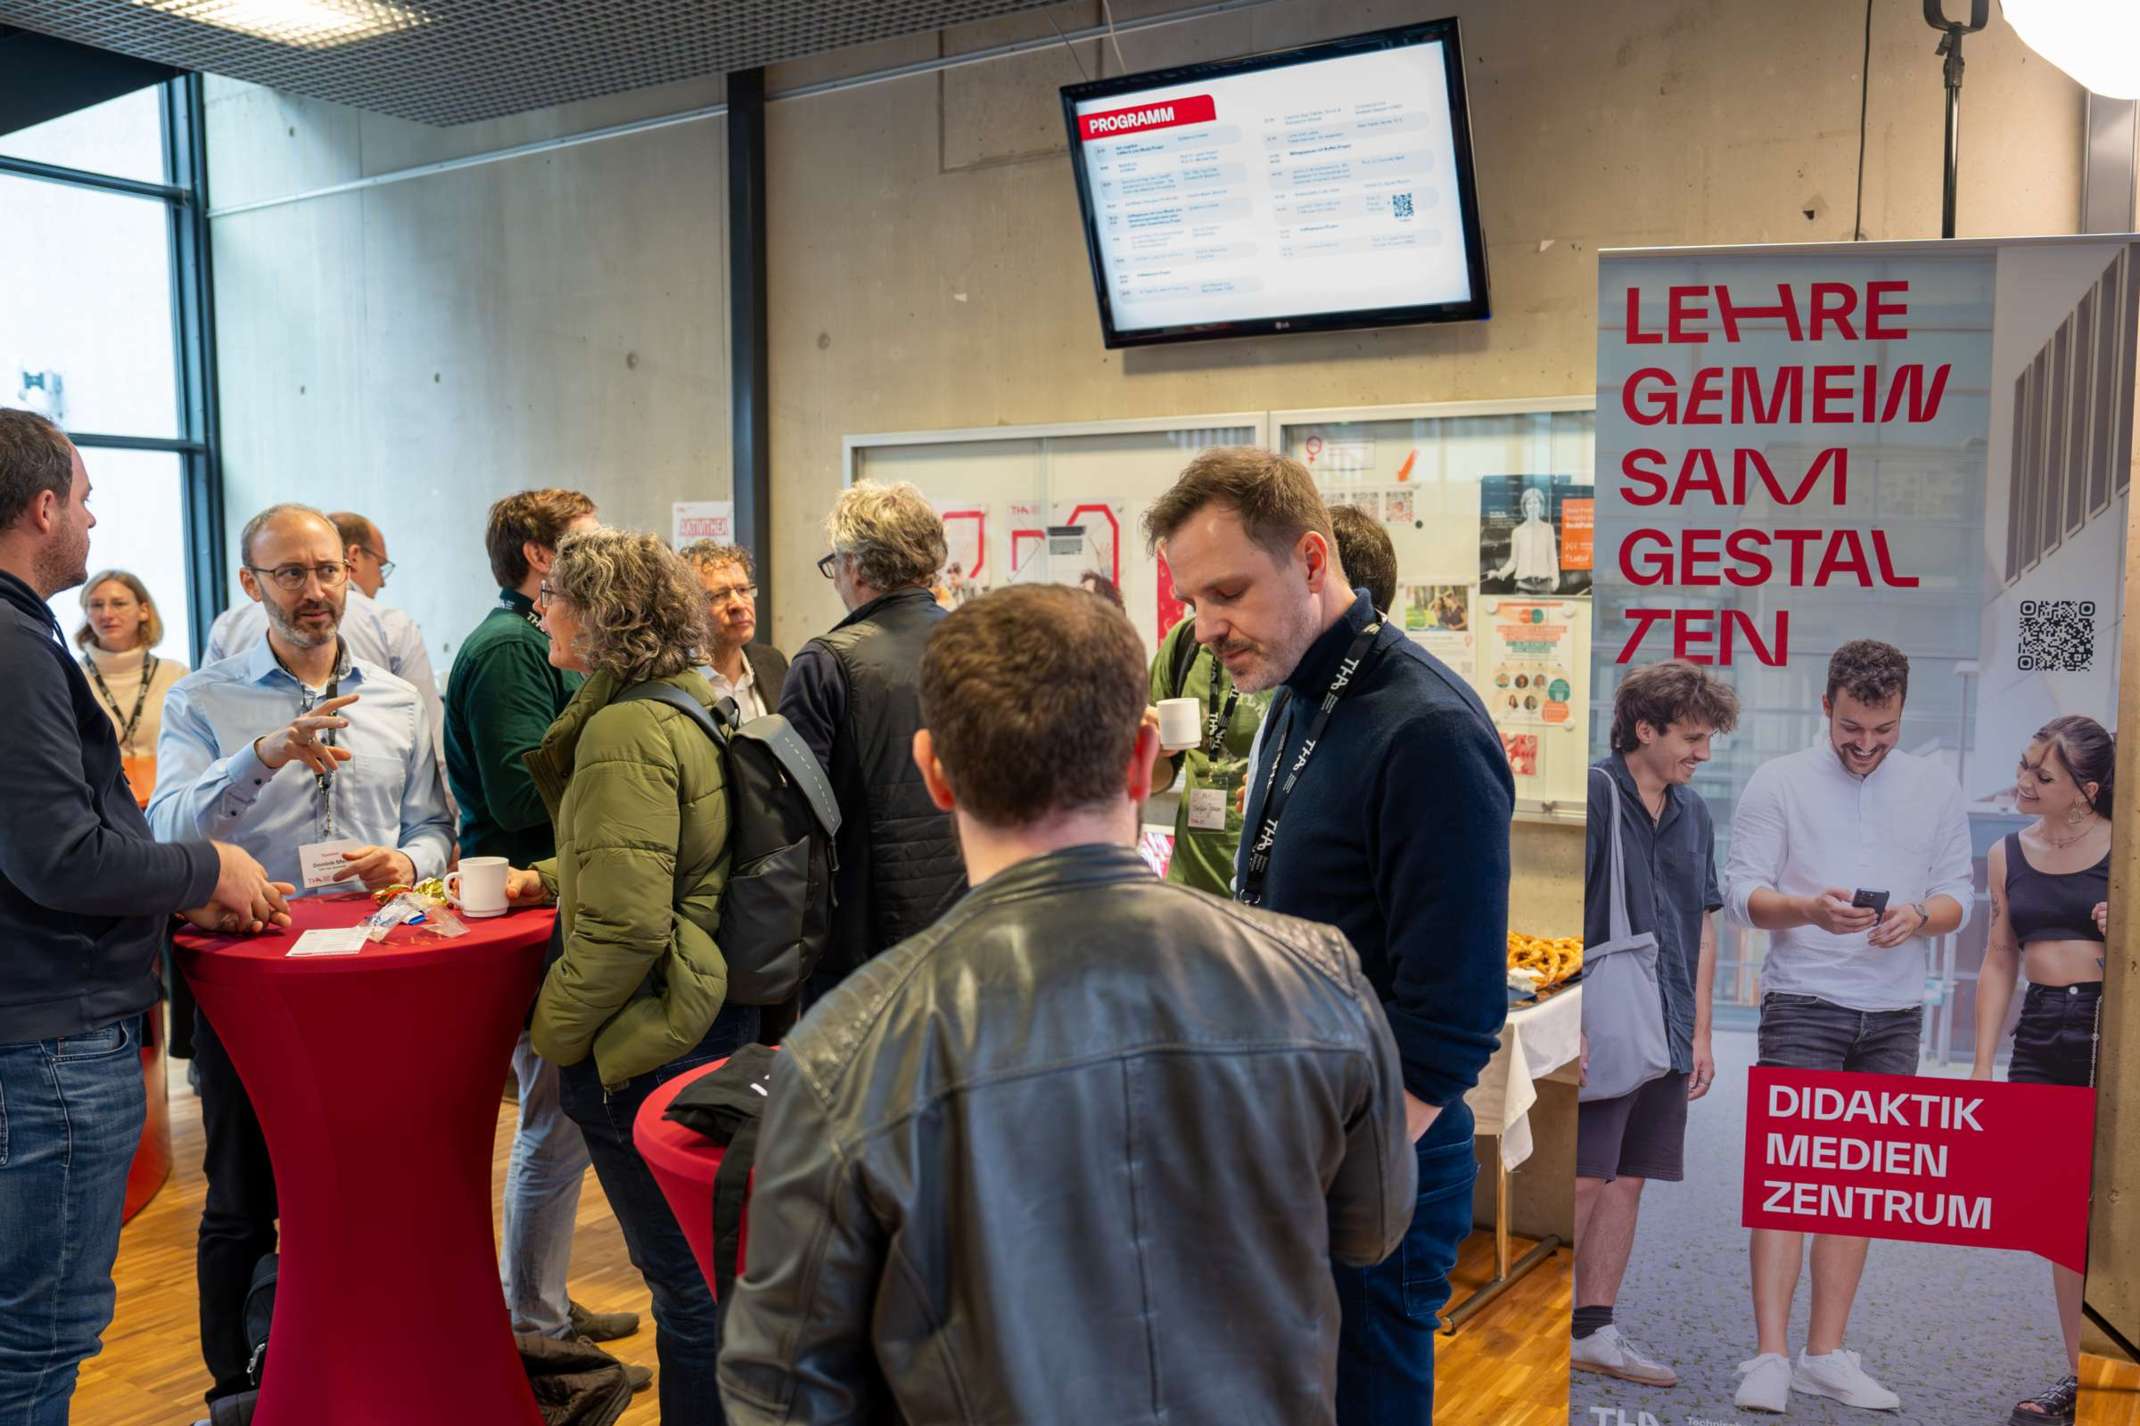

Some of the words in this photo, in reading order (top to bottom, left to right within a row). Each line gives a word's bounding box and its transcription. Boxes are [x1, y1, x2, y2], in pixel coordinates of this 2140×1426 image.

[1089, 107, 1175, 135] PROGRAMM
[1625, 281, 1909, 344] LEHRE
[1622, 363, 1952, 425] GEMEIN
[1619, 447, 1848, 505] SAM
[1618, 529, 1920, 588] GESTAL
[1616, 608, 1789, 667] TEN
[1768, 1085, 1985, 1133] DIDAKTIK
[1765, 1132, 1949, 1178] MEDIEN
[1762, 1180, 1992, 1231] ZENTRUM
